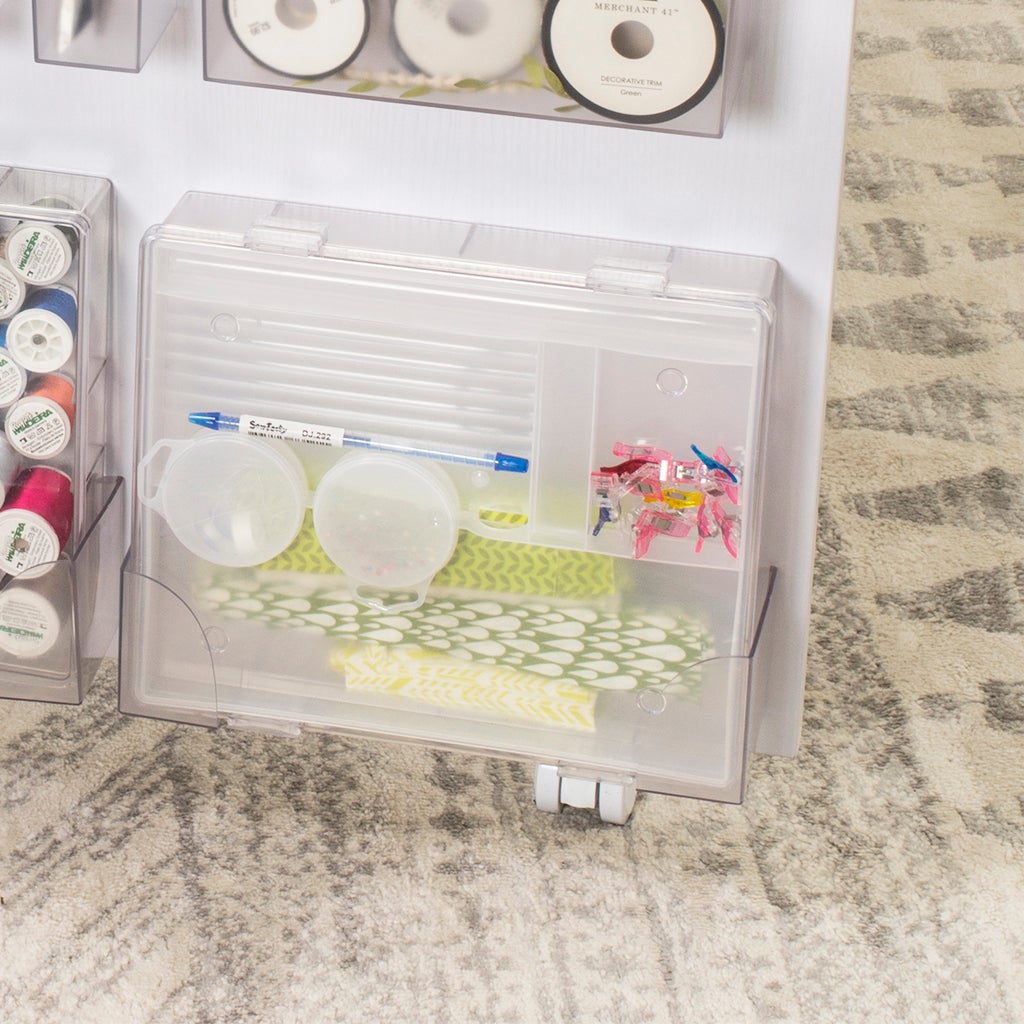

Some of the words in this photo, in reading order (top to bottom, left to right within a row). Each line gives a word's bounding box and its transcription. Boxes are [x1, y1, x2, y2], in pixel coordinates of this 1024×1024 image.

[594, 2, 657, 15] MERCHANT
[600, 75, 645, 86] DECORATIVE
[646, 79, 663, 87] TRIM
[620, 89, 642, 97] Green
